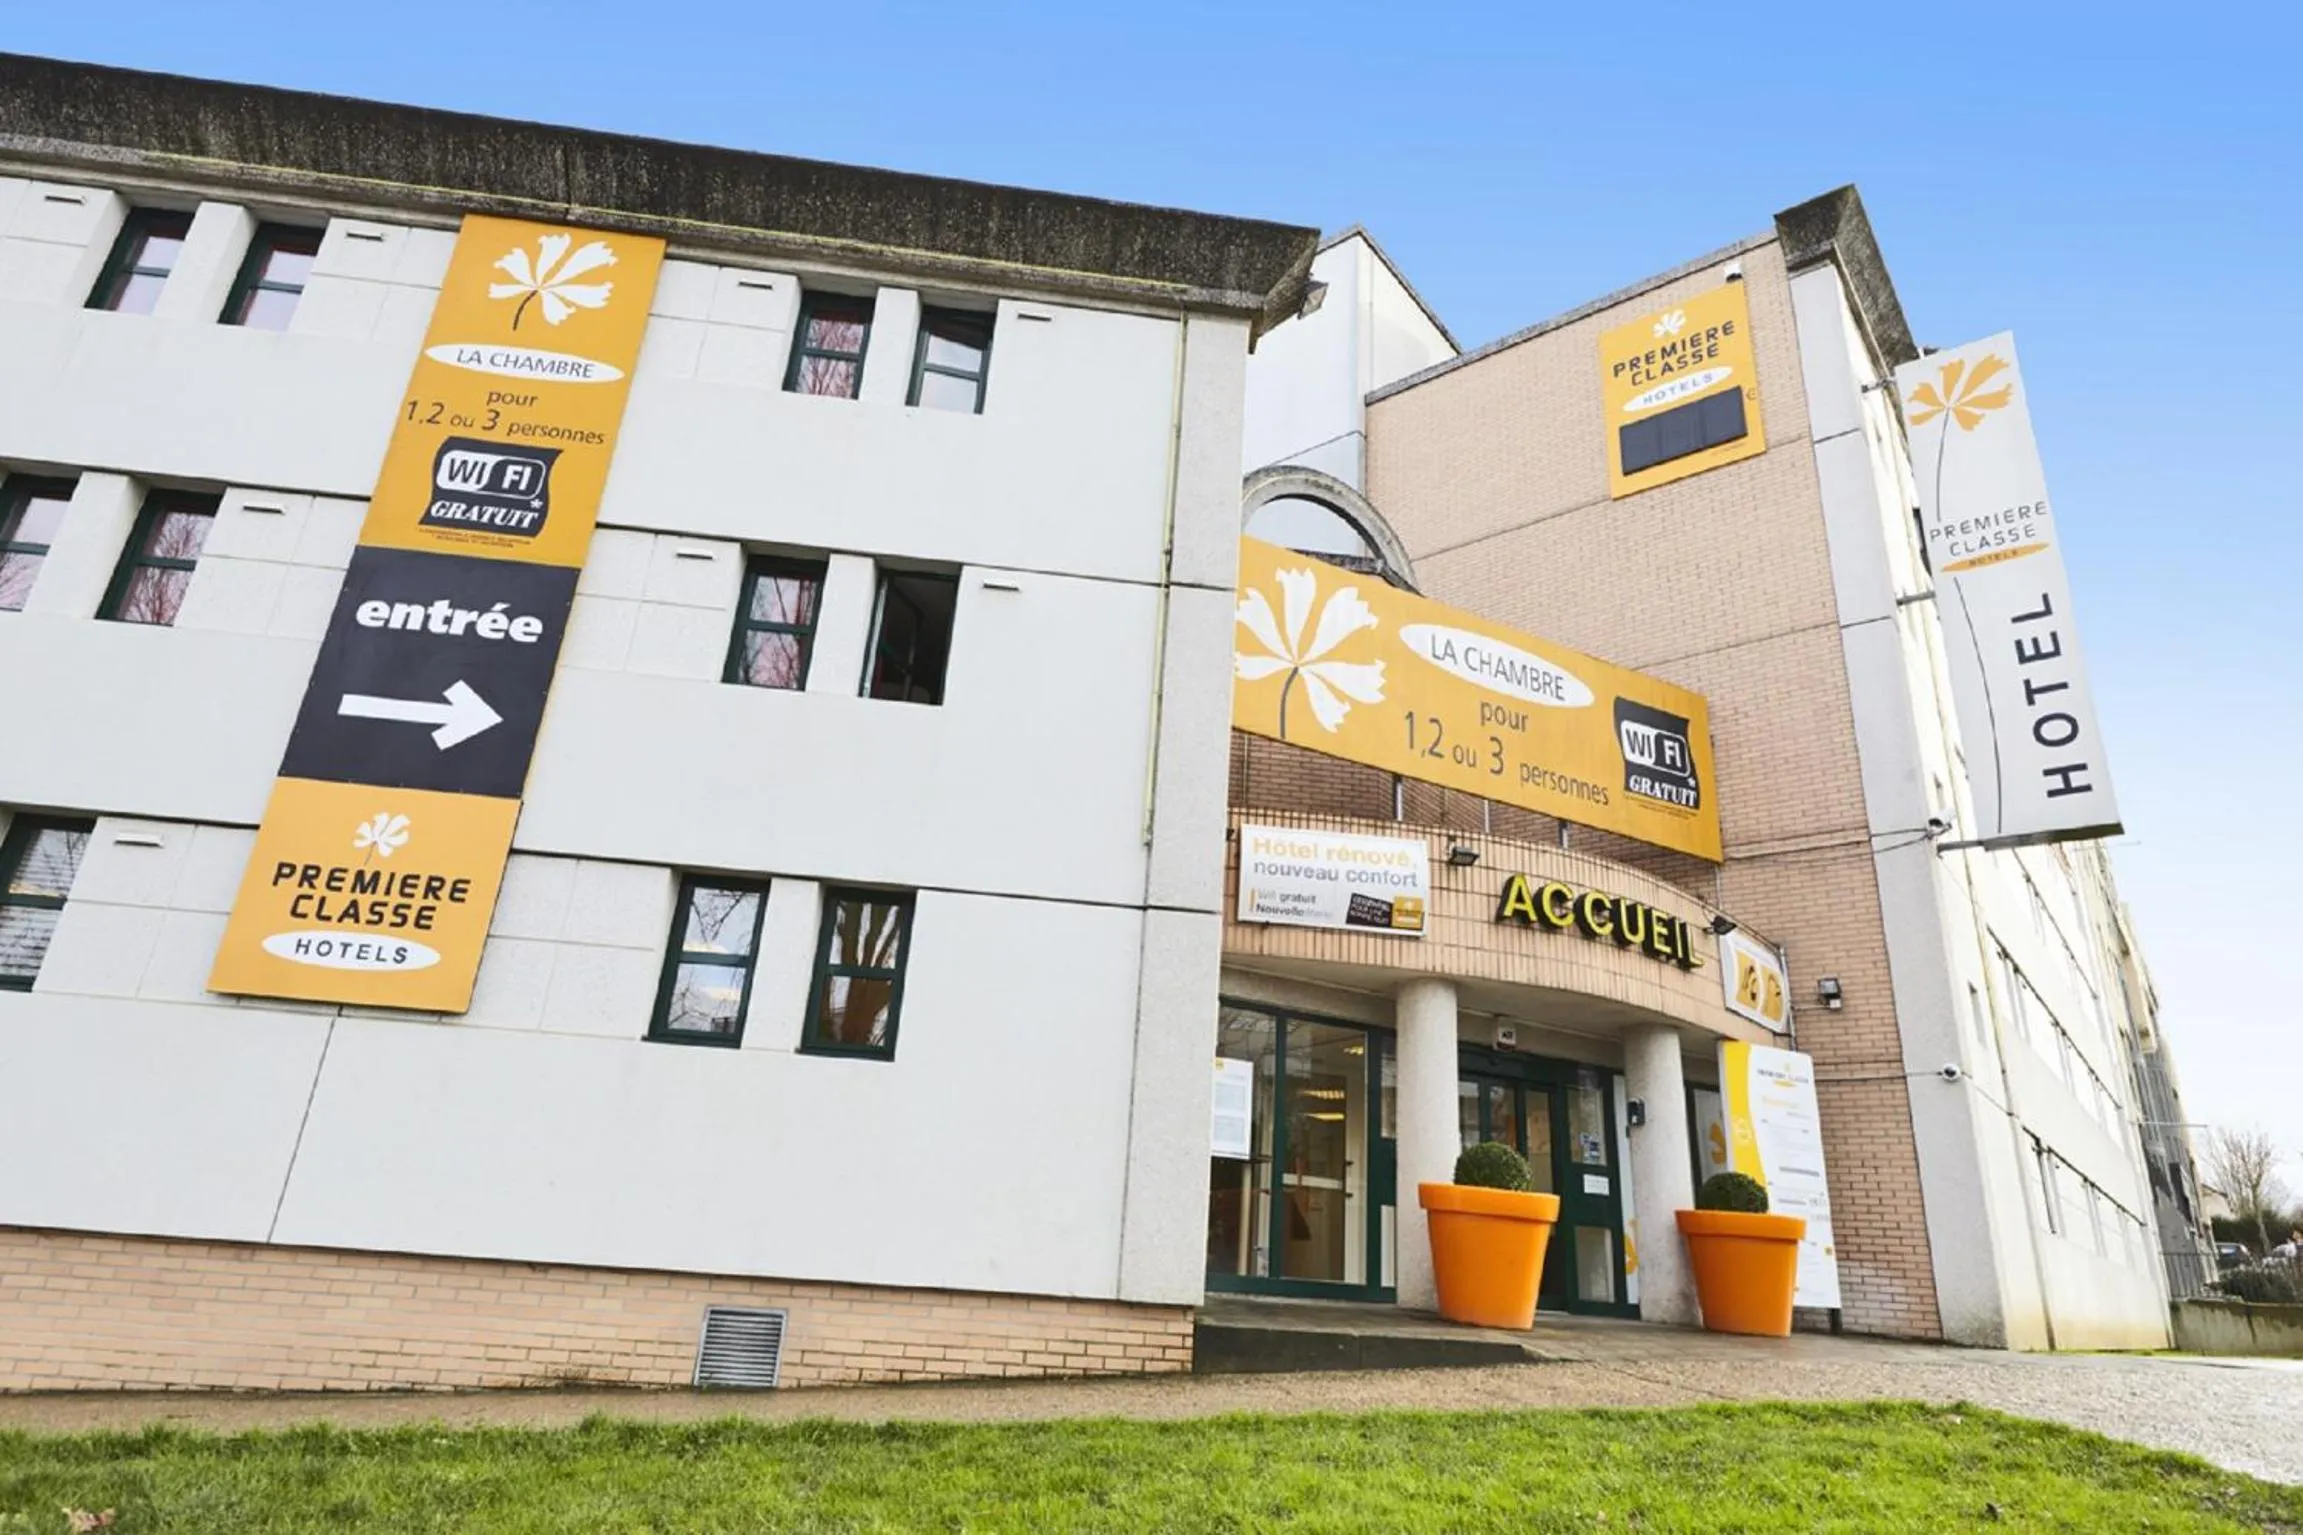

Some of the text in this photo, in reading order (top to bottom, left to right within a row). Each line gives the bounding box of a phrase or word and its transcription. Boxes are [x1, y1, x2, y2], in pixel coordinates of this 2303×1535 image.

[456, 348, 596, 379] LA CHAMBRE
[1612, 320, 1736, 379] PREMIERE
[1631, 343, 1720, 387] CLASSE
[486, 391, 539, 408] pour
[1642, 373, 1714, 405] HOTELS
[450, 413, 476, 428] ou
[481, 408, 501, 432] 3
[506, 420, 605, 446] personnes
[1928, 500, 2048, 543] PREMIERE
[1949, 523, 2036, 557] CLASSE
[355, 598, 543, 643] entrée
[1430, 632, 1566, 702] LA CHAMBRE
[2011, 592, 2093, 799] HOTEL
[1480, 700, 1530, 734] pour
[1452, 743, 1478, 769] ou
[1488, 735, 1505, 777] 3
[1519, 760, 1610, 808] personnes
[1663, 738, 1682, 768] FI
[271, 861, 472, 904] PREMIERE
[1253, 861, 1419, 888] nouveau confort
[289, 893, 437, 931] CLASSE
[1280, 892, 1317, 904] gratuit
[1500, 872, 1704, 967] ACCUEIL
[294, 938, 409, 965] HOTELS
